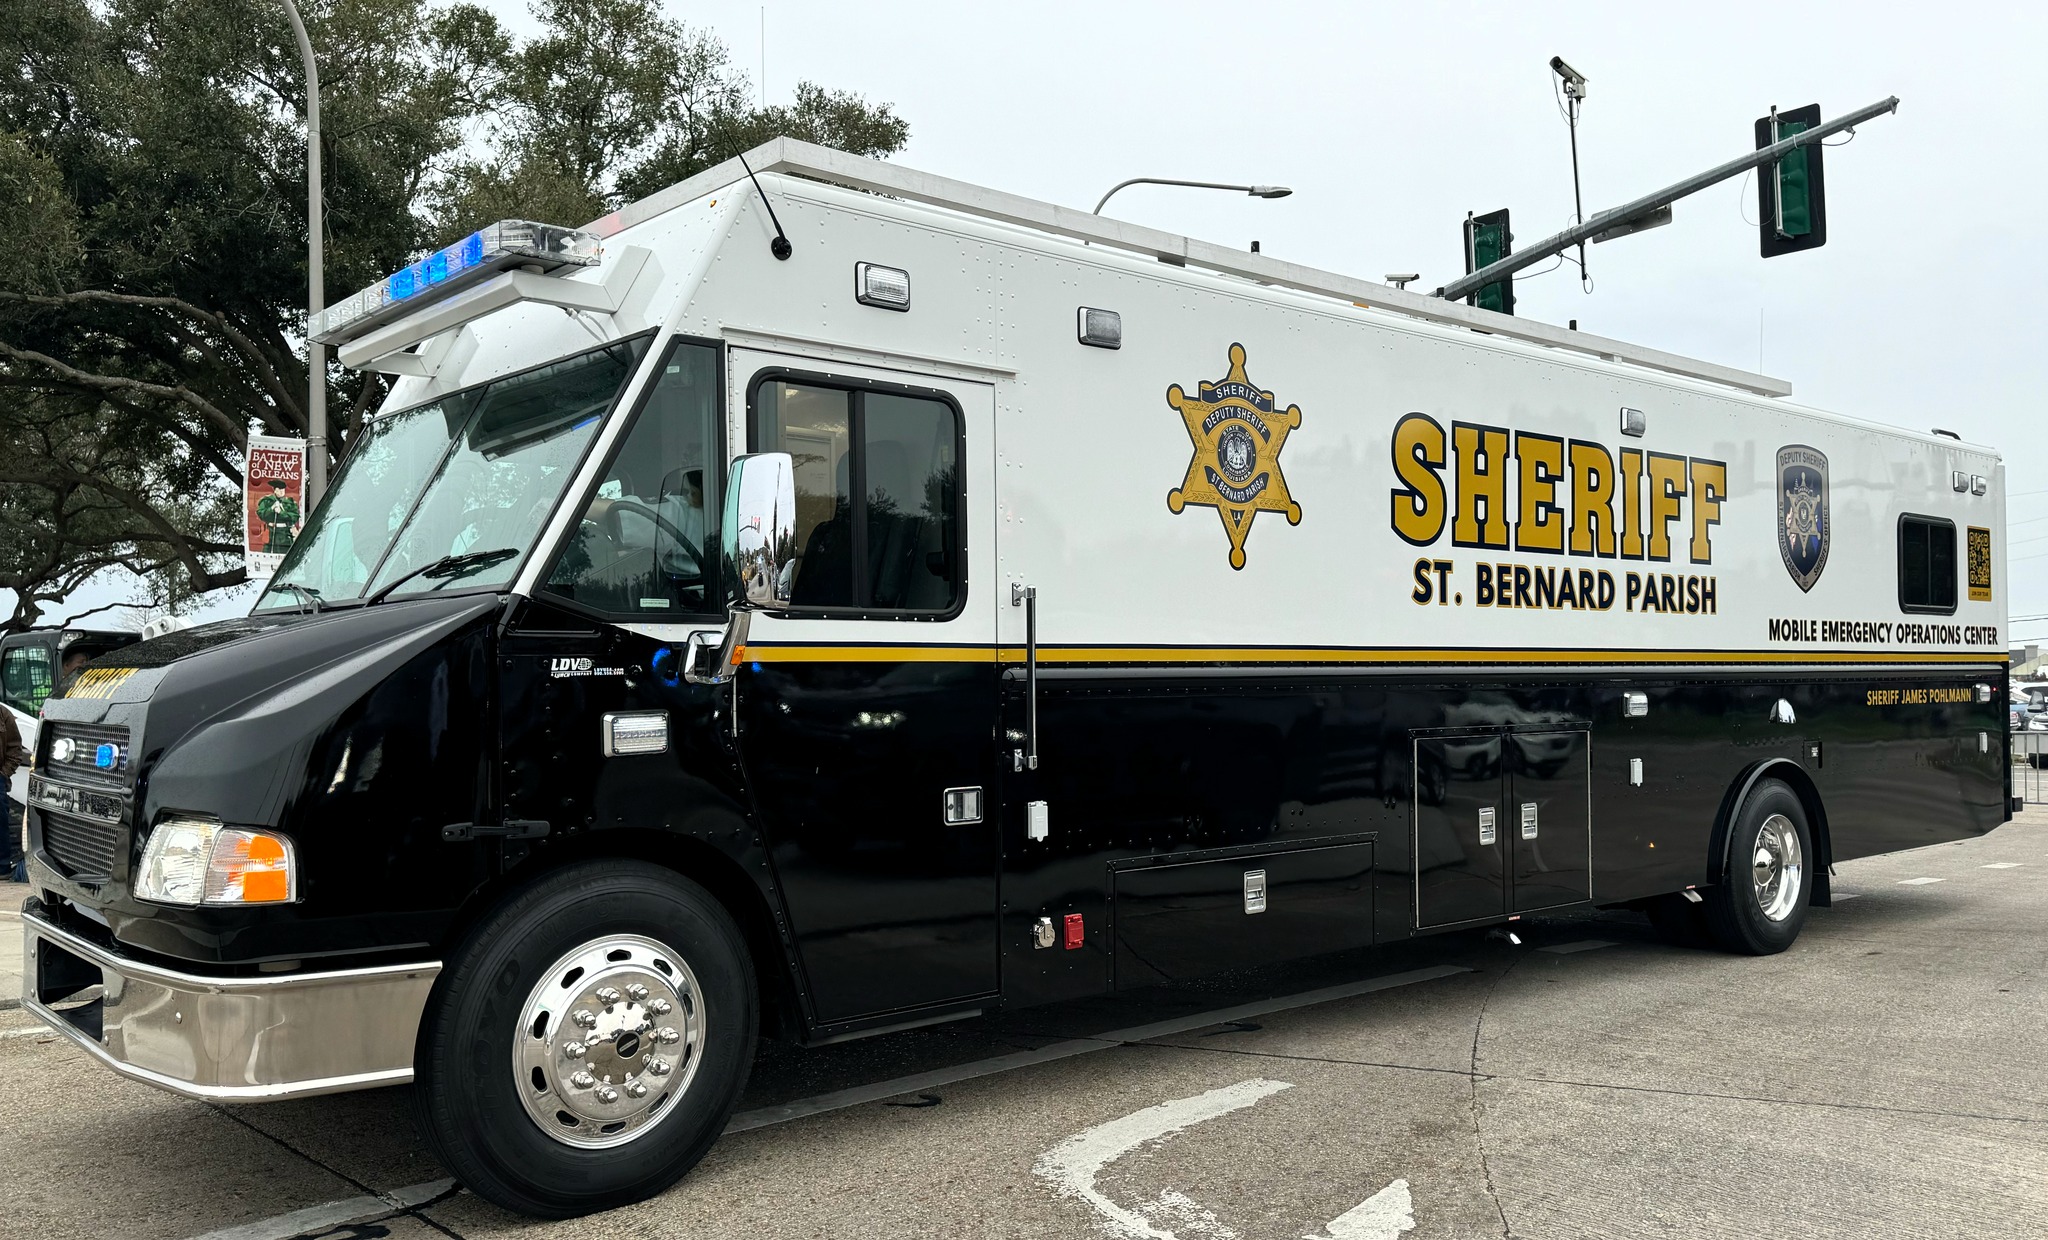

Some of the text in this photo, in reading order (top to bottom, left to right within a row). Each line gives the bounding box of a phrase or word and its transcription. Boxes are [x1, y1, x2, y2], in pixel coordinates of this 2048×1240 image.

[1216, 385, 1261, 404] SHERIFF
[1205, 407, 1267, 433] DEPUTY SHERIFF
[1222, 425, 1239, 436] STATE
[251, 460, 295, 472] of NEW
[252, 452, 299, 464] BATTLE
[1779, 452, 1826, 471] DEPUTY SHERIFF
[250, 469, 300, 480] ORLEANS
[1222, 467, 1251, 482] LOUISIANA
[1211, 473, 1265, 501] ST BERNARD PARISH
[1391, 412, 1727, 565] SHERIFF
[1233, 512, 1241, 521] LA
[1411, 557, 1717, 615] ST. BERNARD PARISH
[1769, 618, 1998, 645] MOBILE EMERGENCY OPERATIONS CENTER
[551, 658, 580, 671] LDV
[65, 668, 140, 700] SHERIFF
[1867, 687, 1972, 706] SHERIFF JAMES POHLMANN
